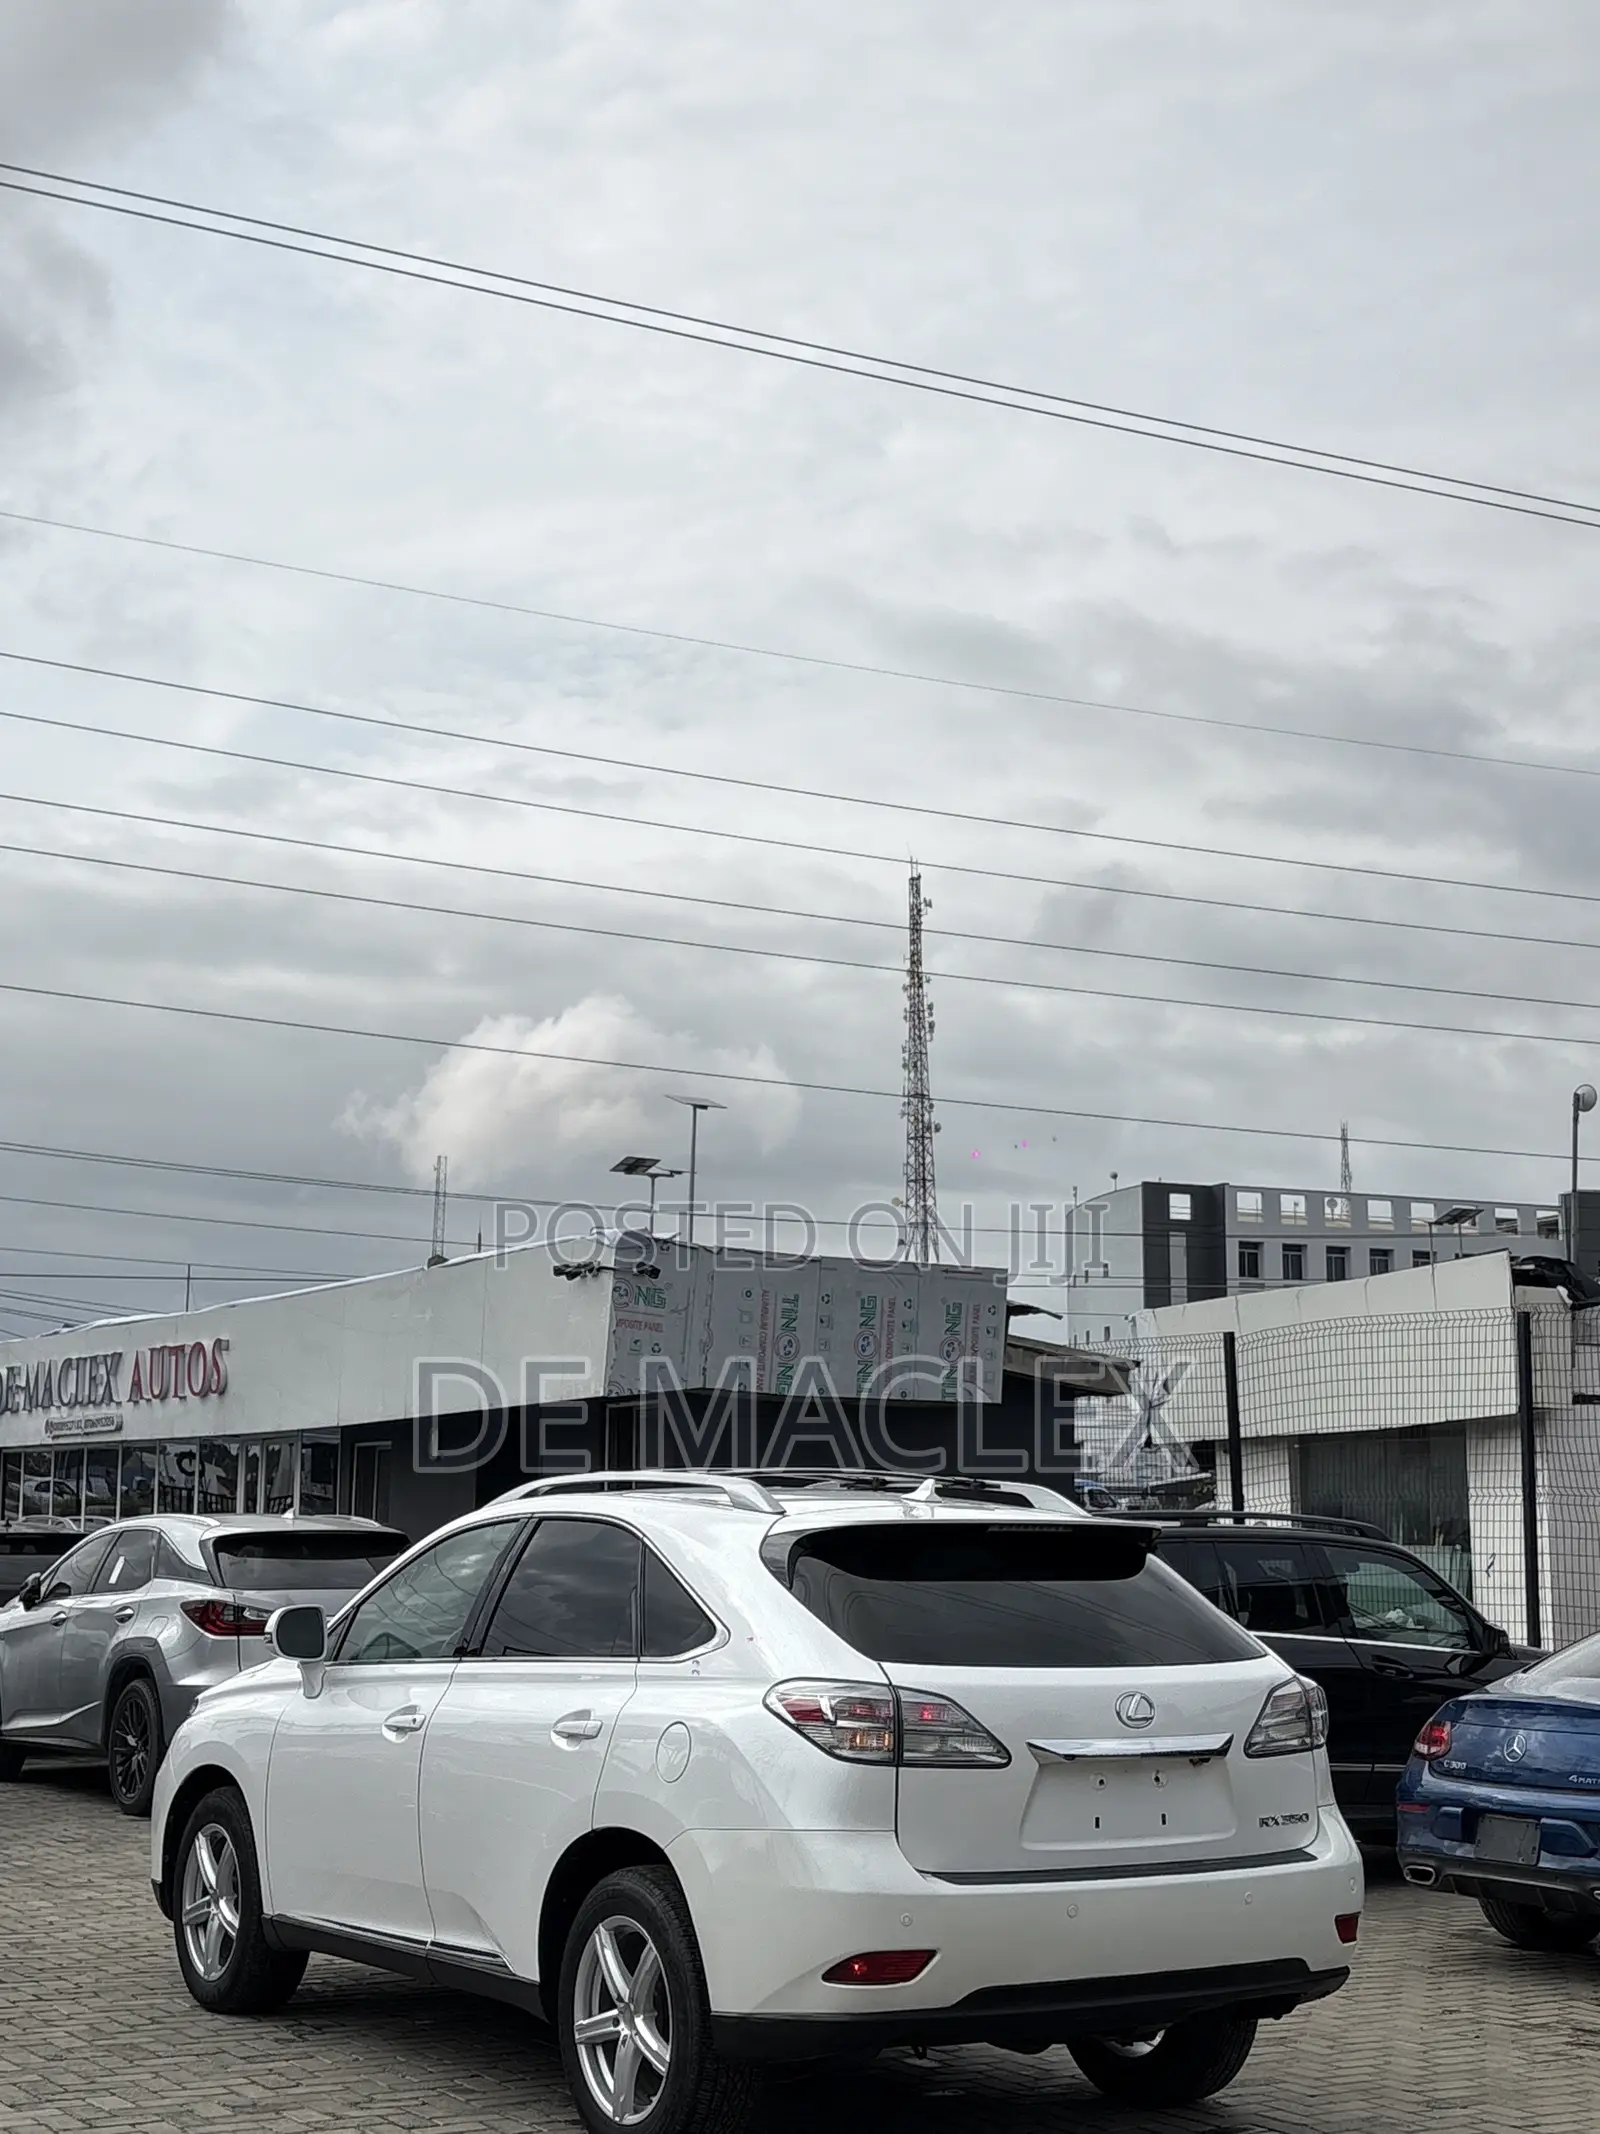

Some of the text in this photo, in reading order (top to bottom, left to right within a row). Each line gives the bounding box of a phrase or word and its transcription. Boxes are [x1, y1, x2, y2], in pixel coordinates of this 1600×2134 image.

[127, 1338, 230, 1402] AUTOS
[1259, 1813, 1309, 1828] RX 350
